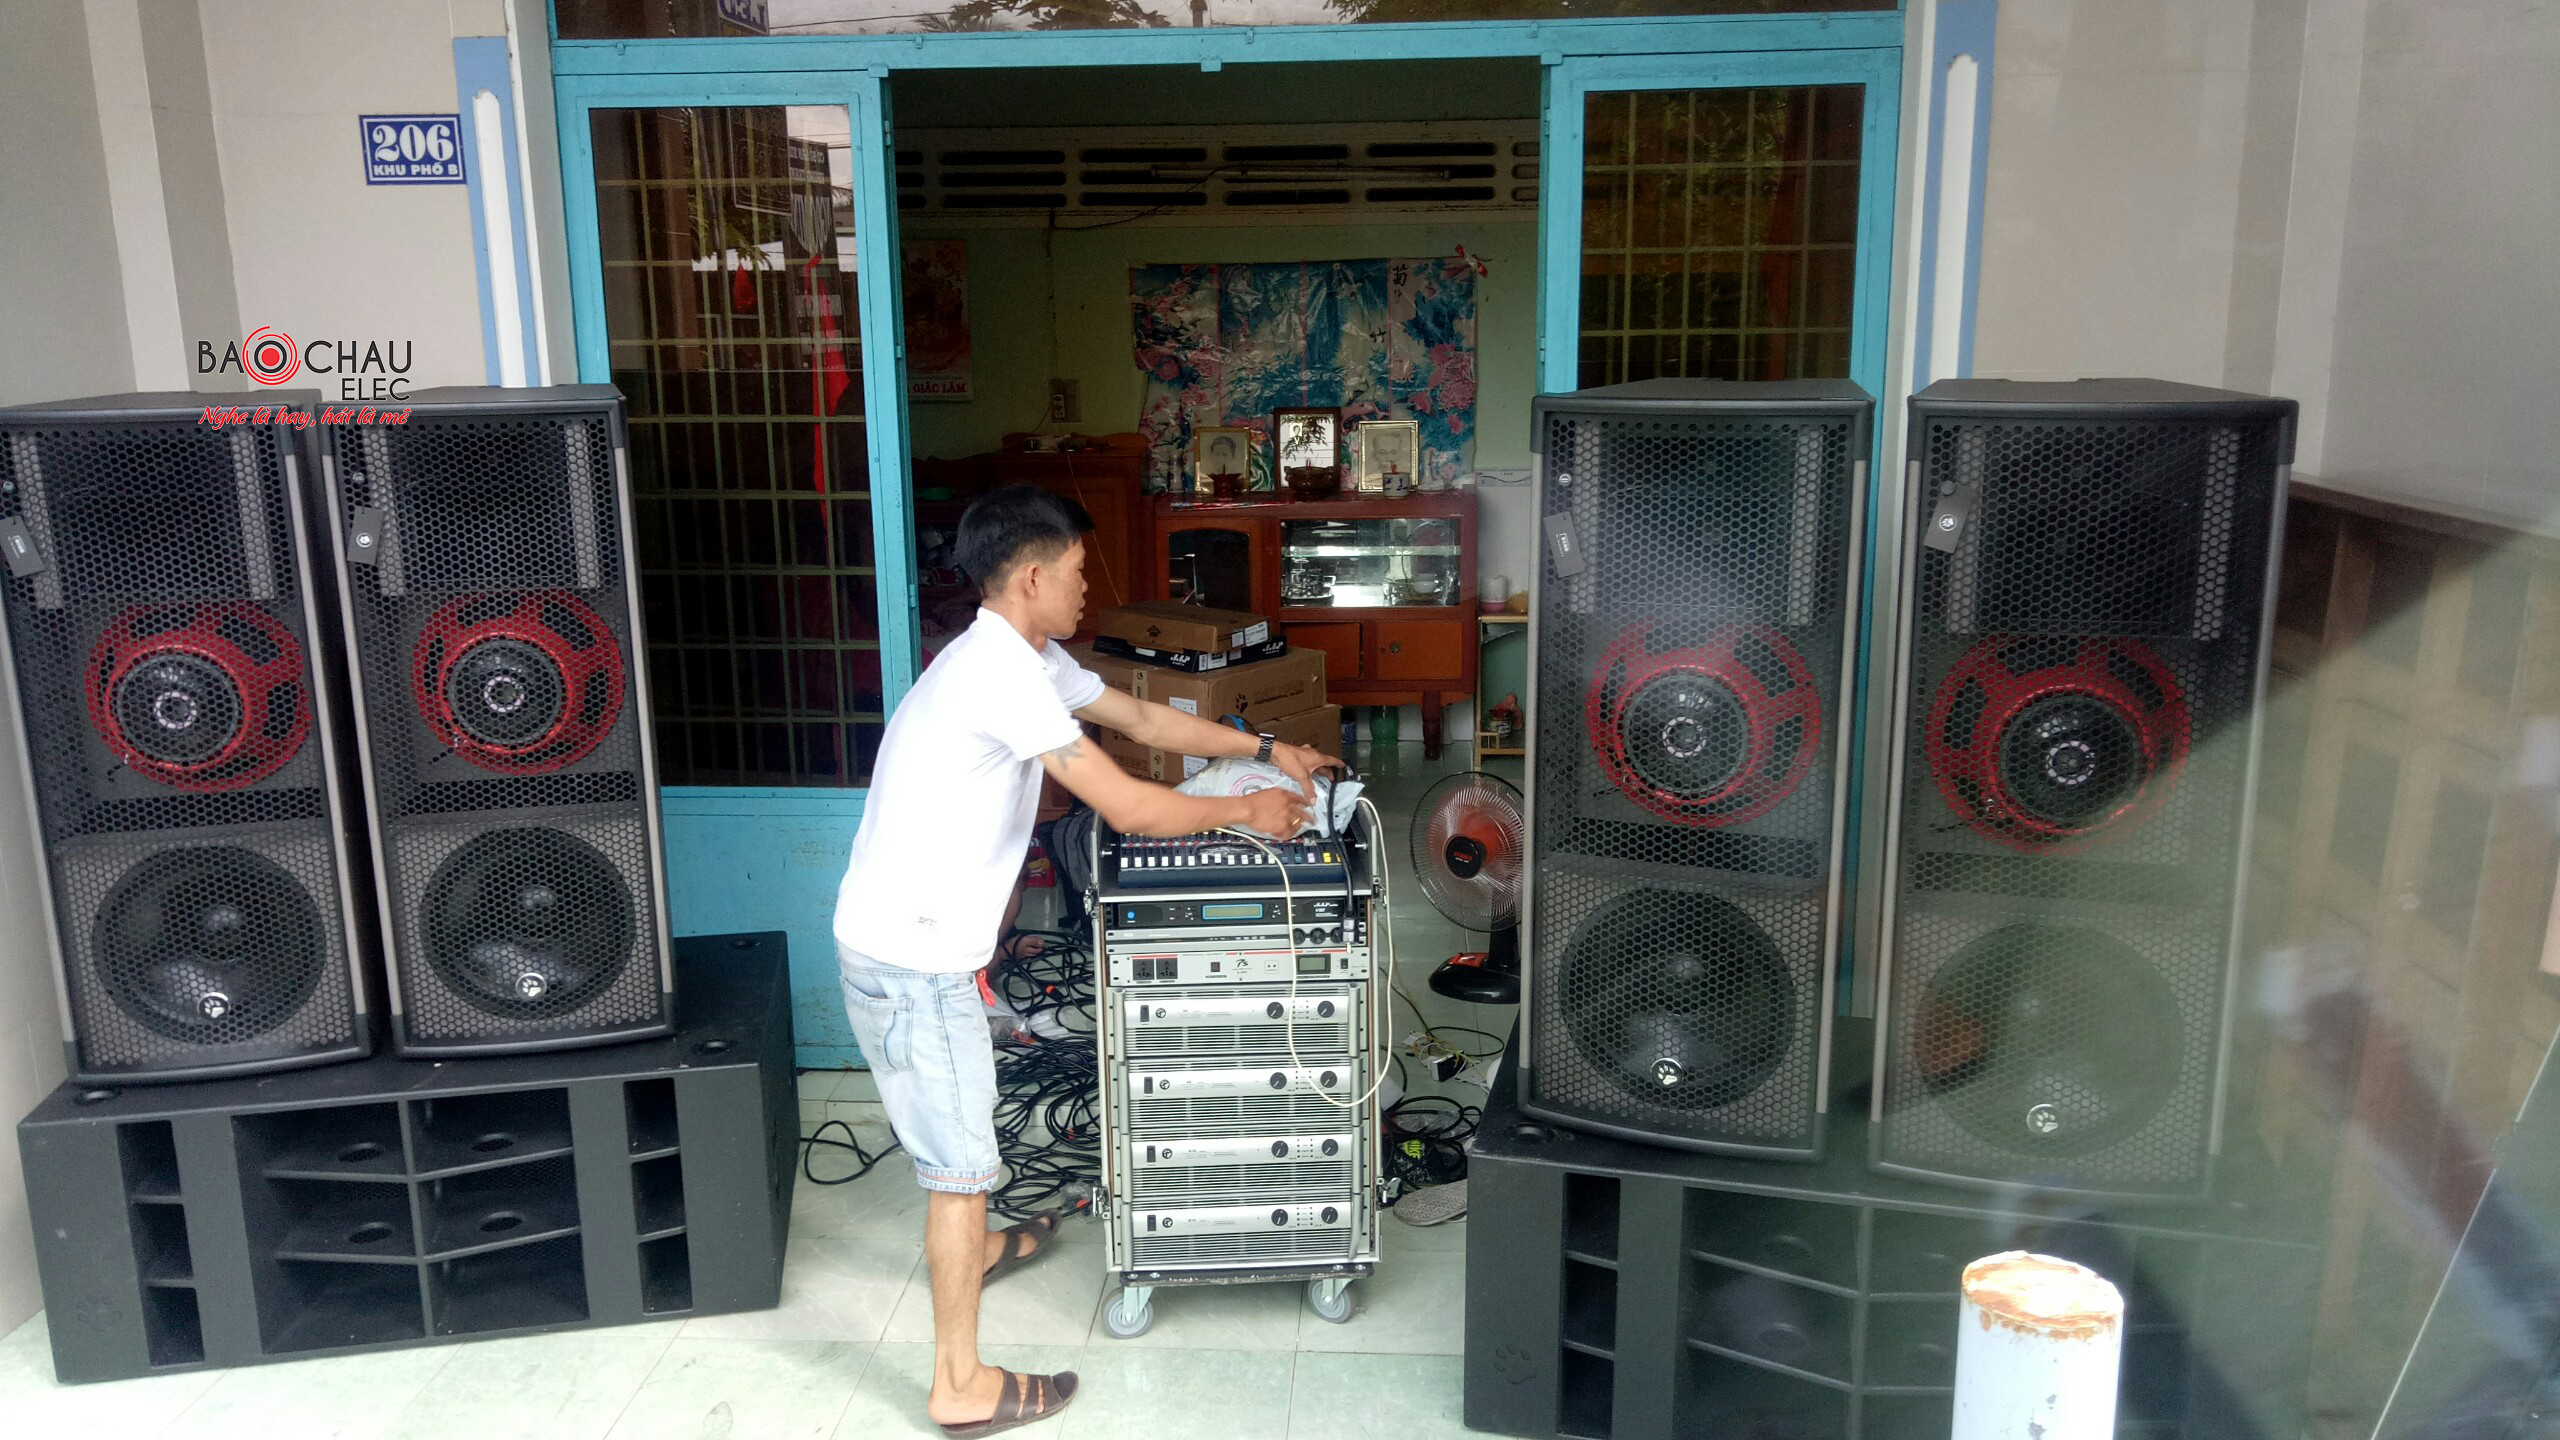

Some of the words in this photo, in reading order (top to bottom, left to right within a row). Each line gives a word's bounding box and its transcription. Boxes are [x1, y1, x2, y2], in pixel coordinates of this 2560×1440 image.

[372, 124, 454, 162] 206
[373, 164, 406, 176] KHU
[410, 161, 444, 176] PHỐ
[912, 381, 939, 393] GIÁC
[943, 381, 966, 393] LÂM
